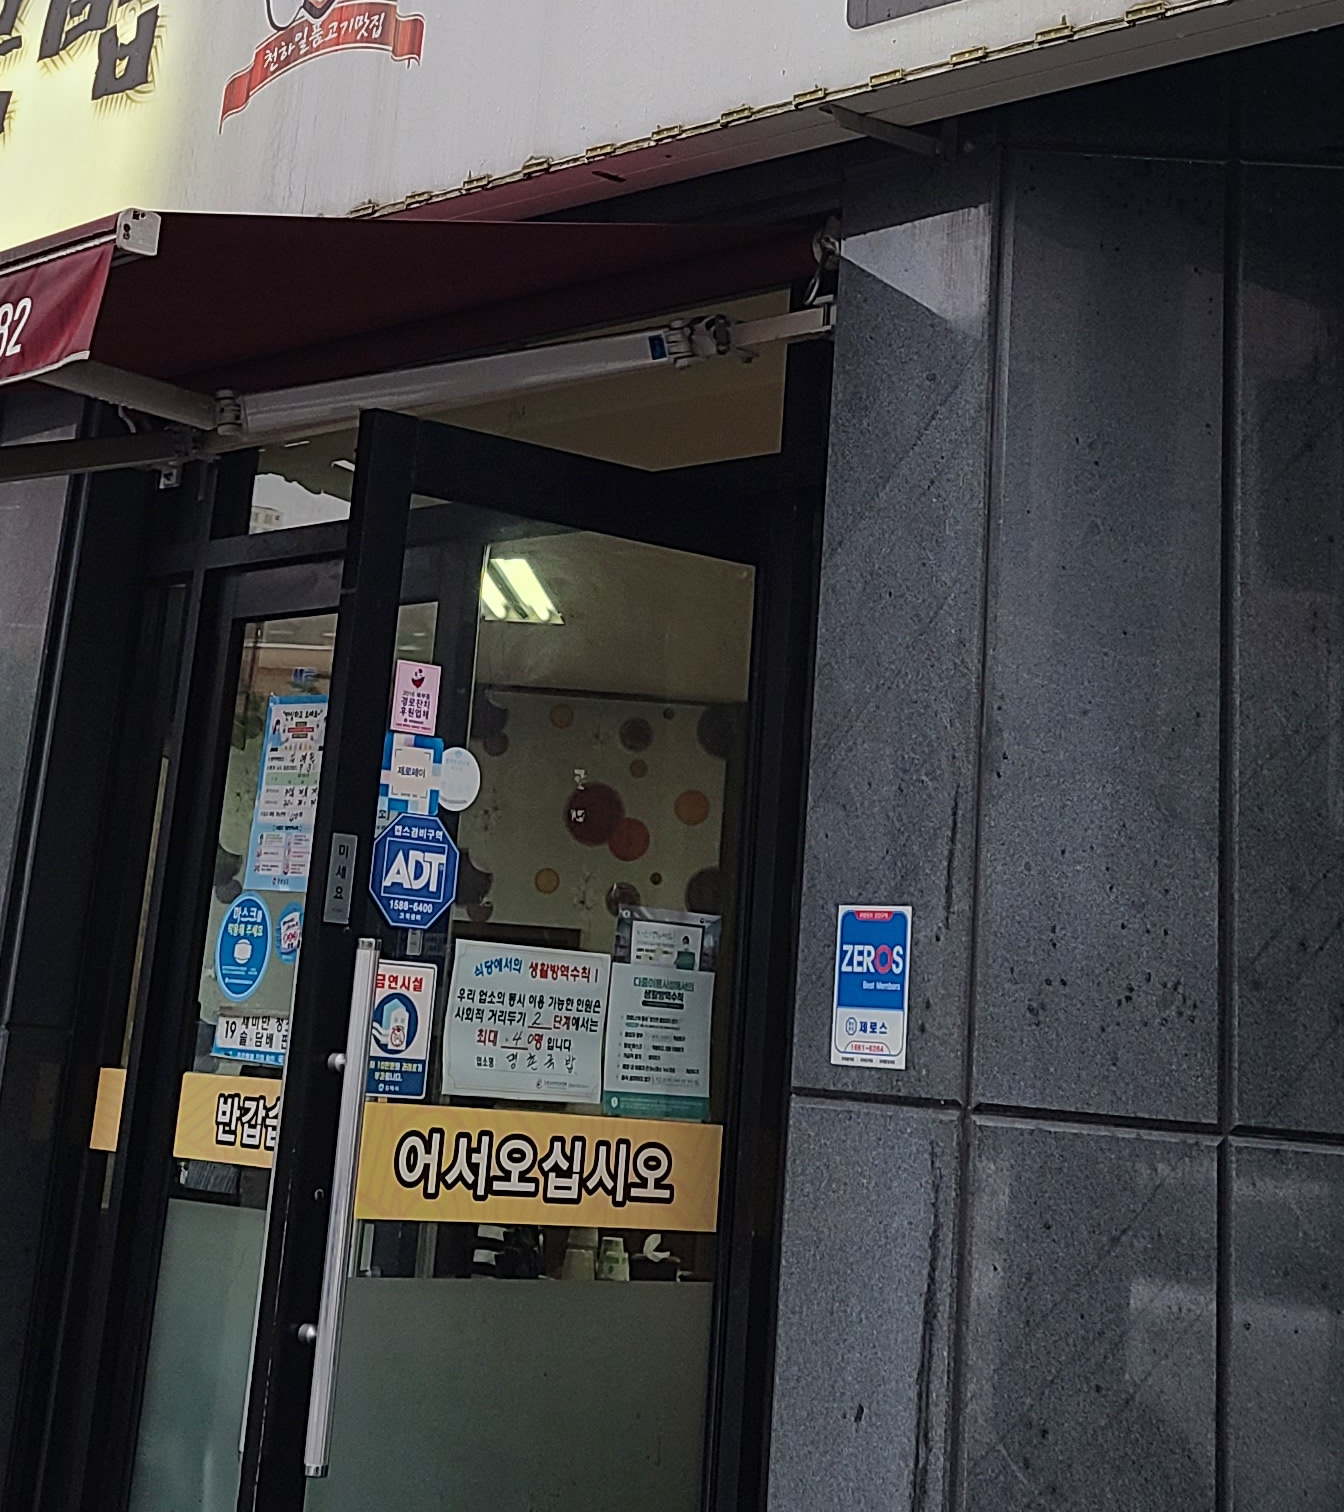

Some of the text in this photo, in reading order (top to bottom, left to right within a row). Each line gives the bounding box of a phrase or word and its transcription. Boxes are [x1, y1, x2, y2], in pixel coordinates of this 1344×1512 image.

[383, 849, 446, 893] ADT
[474, 957, 523, 977] 식당에서의
[528, 961, 591, 983] 생활방역수칙
[841, 944, 904, 974] ZEROS
[376, 973, 423, 992] 금연시설
[457, 988, 476, 1003] 우리
[478, 989, 506, 1005] 업소의
[528, 994, 545, 1009] 이용
[548, 996, 575, 1013] 가능한
[487, 1009, 527, 1027] 거리두기
[859, 1021, 888, 1034] 제로스
[225, 1020, 237, 1039] 19
[476, 1028, 498, 1046] 최대
[396, 1129, 674, 1208] 어서오십시오
